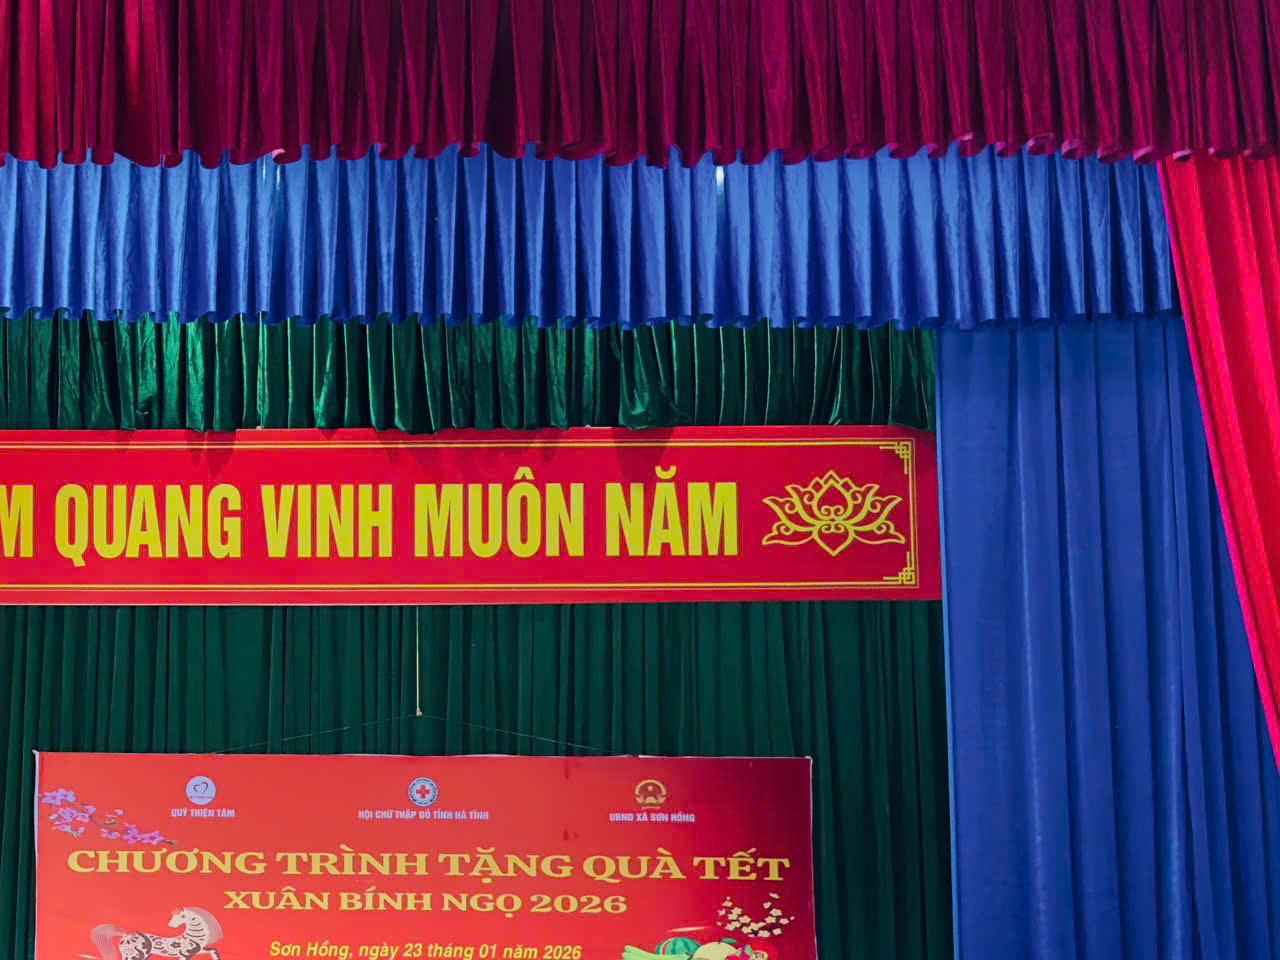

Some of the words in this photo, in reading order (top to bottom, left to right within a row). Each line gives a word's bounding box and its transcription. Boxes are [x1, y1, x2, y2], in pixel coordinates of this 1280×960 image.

[56, 484, 241, 567] QUANG
[261, 484, 392, 557] VINH
[414, 467, 584, 558] MUÔN
[606, 466, 738, 556] NĂM
[171, 808, 187, 817] QUỸ
[190, 808, 214, 818] THIỆN
[216, 808, 235, 817] TÂM
[359, 810, 373, 820] HỘI
[394, 810, 417, 820] THẬP
[636, 812, 648, 821] XÃ
[650, 813, 668, 821] SƠN
[671, 811, 695, 822] HỒNG
[68, 848, 267, 874] CHƯƠNG
[276, 844, 428, 875] TRÌNH
[438, 847, 573, 884] TẶNG
[583, 848, 686, 883] QUÀ
[693, 848, 790, 880] TẾT
[224, 886, 330, 910] XUÂN
[339, 886, 432, 910] BÍNH
[442, 894, 522, 918] NGỌ
[530, 895, 627, 913] 2026
[270, 941, 301, 957] Sơn
[306, 940, 354, 959] Hồng,
[359, 942, 398, 959] ngày
[403, 943, 423, 957] 23
[428, 944, 474, 960] tháng
[479, 944, 497, 959] 01
[503, 944, 538, 959] năm
[543, 945, 582, 960] 2026
